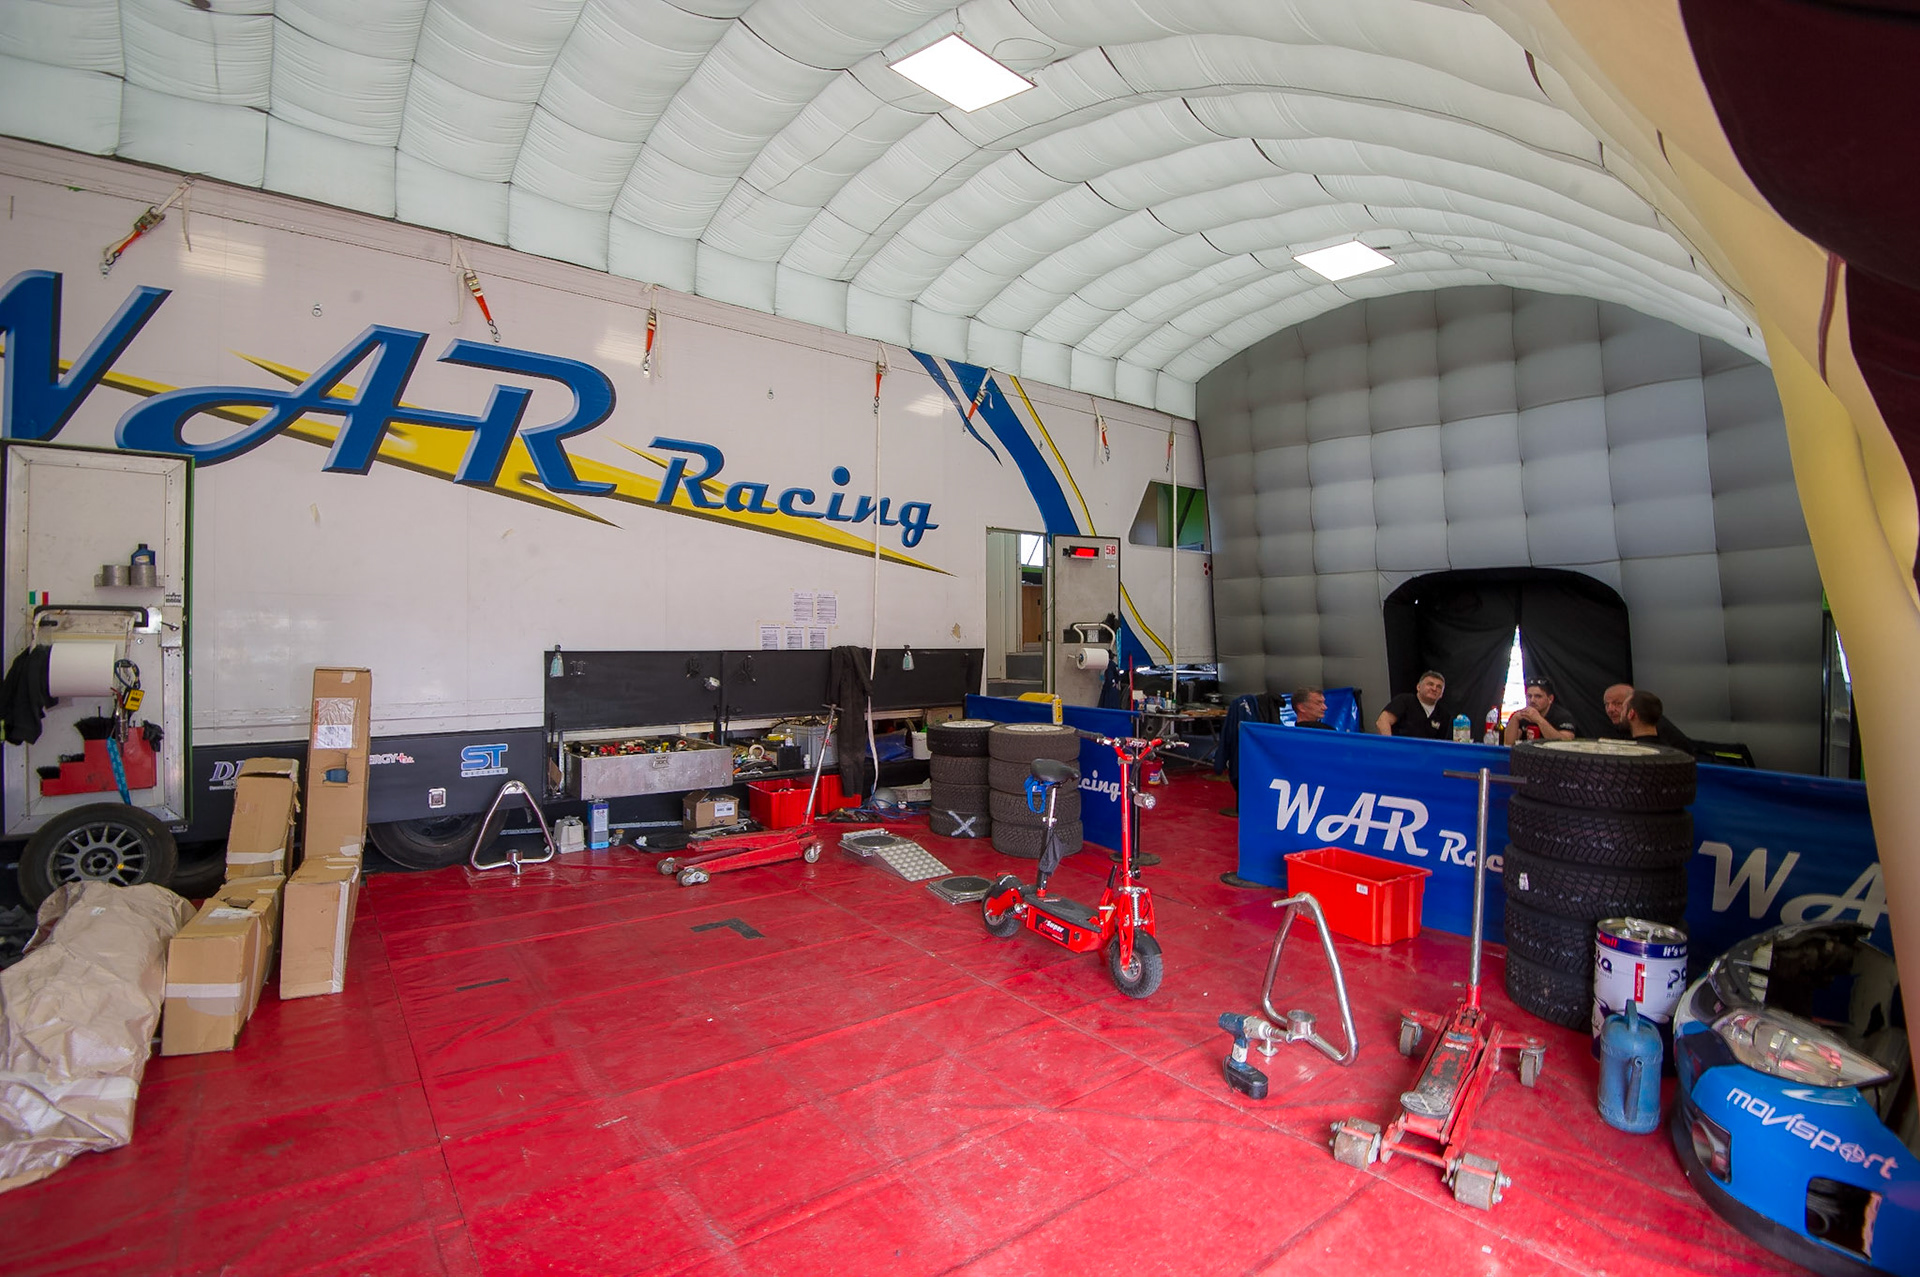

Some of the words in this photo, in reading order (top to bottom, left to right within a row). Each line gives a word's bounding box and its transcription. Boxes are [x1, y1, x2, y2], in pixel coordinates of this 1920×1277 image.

[647, 436, 939, 548] Racing
[1105, 545, 1116, 555] 58
[461, 744, 508, 770] ST
[1079, 769, 1121, 802] cing
[1269, 778, 1429, 857] WAR
[1439, 830, 1504, 872] Rac
[1698, 840, 1888, 939] WA
